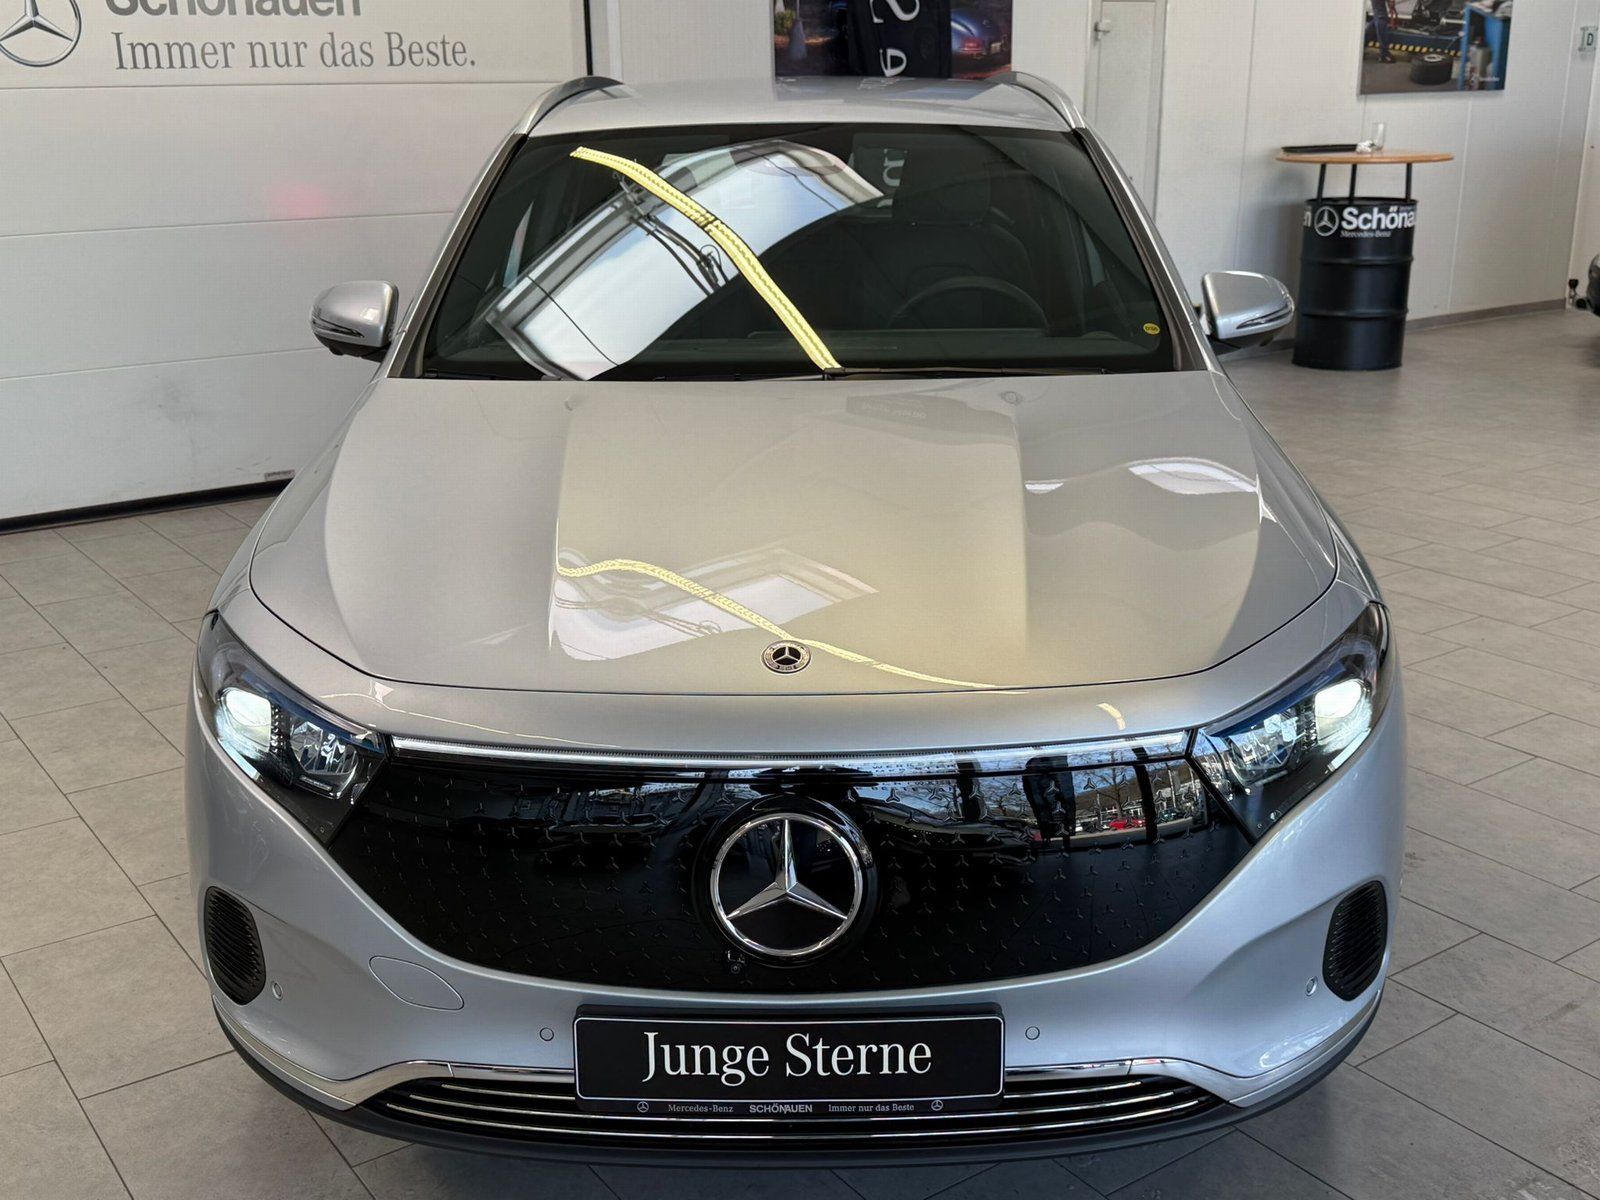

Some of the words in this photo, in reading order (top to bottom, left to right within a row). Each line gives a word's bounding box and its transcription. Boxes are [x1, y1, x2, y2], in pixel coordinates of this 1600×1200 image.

[111, 32, 235, 70] Immer
[248, 41, 308, 68] nur
[320, 32, 374, 68] das
[385, 31, 476, 67] Beste.
[641, 1031, 770, 1087] Junge
[785, 1032, 932, 1077] Sterne
[668, 1103, 734, 1113] Mercedes-Benz
[749, 1103, 813, 1114] SCHÖNAUEN
[828, 1104, 856, 1112] Immer
[875, 1103, 890, 1112] das
[892, 1103, 915, 1112] Beste
